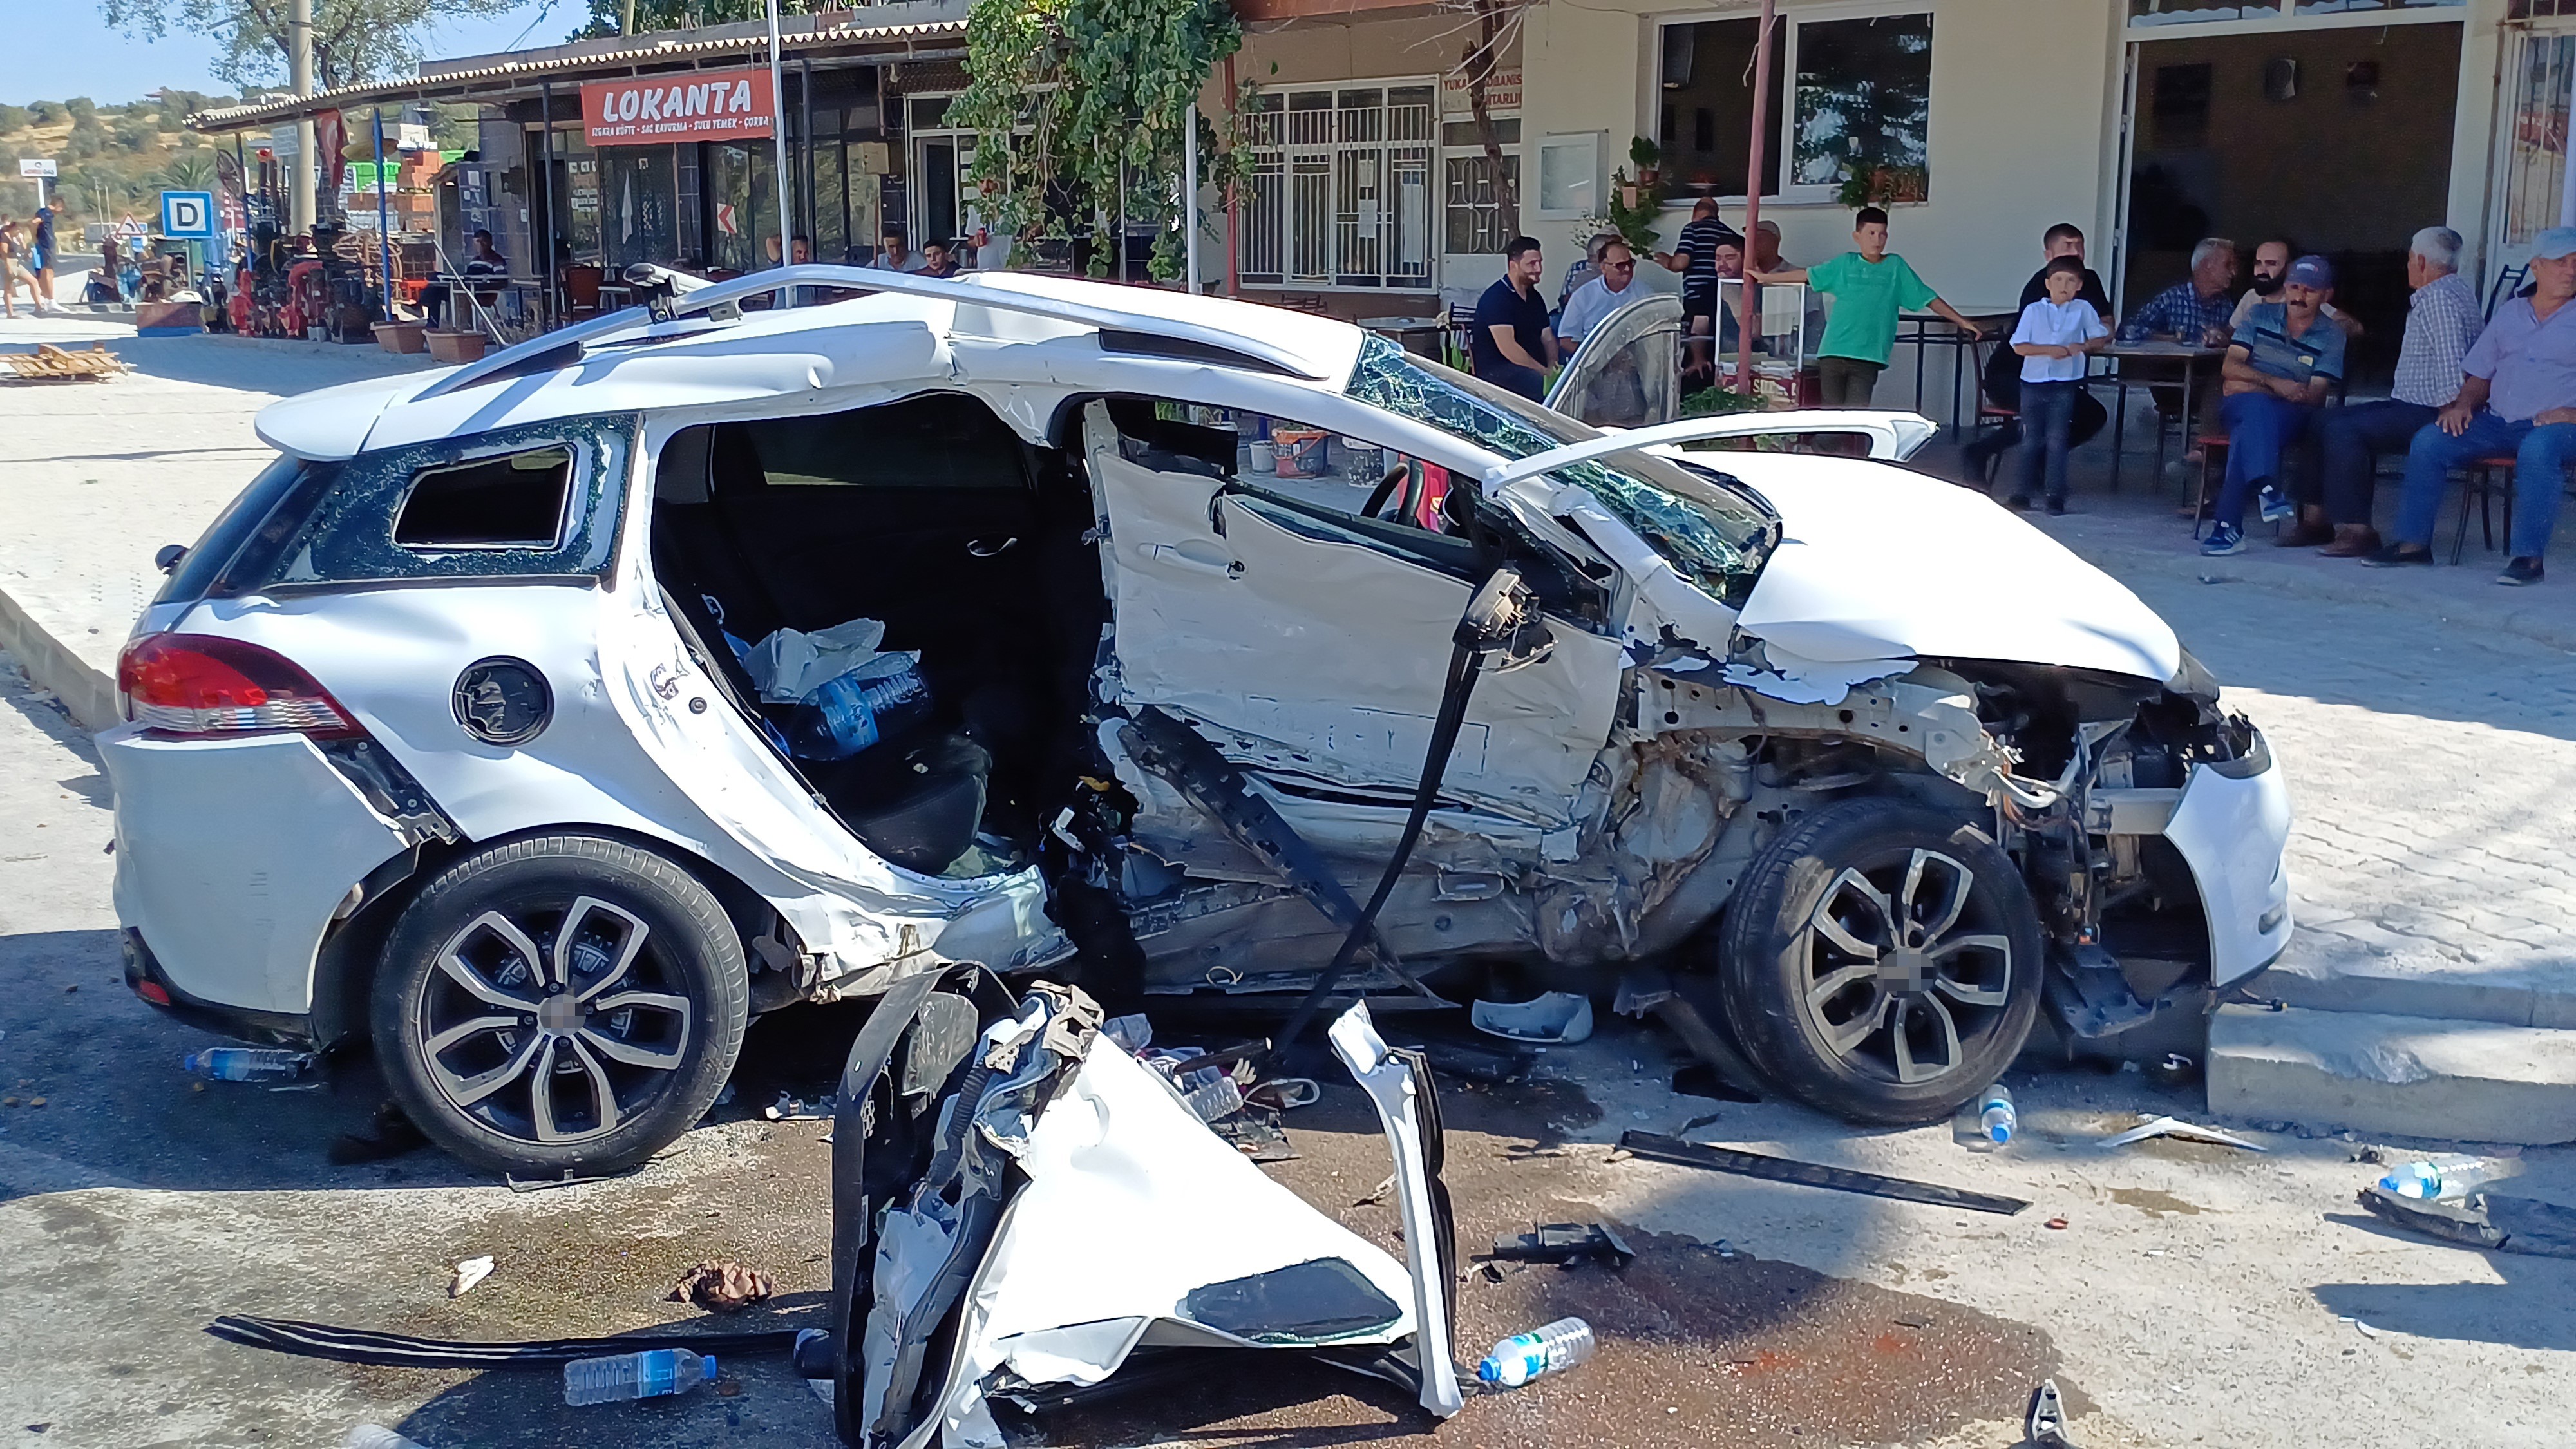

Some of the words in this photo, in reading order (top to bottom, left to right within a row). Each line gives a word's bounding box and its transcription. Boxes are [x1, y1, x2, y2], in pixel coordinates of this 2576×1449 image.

[603, 80, 752, 122] LOKANTA
[712, 118, 737, 129] YEMEK
[744, 116, 769, 129] ÇORBA
[176, 202, 198, 227] D
